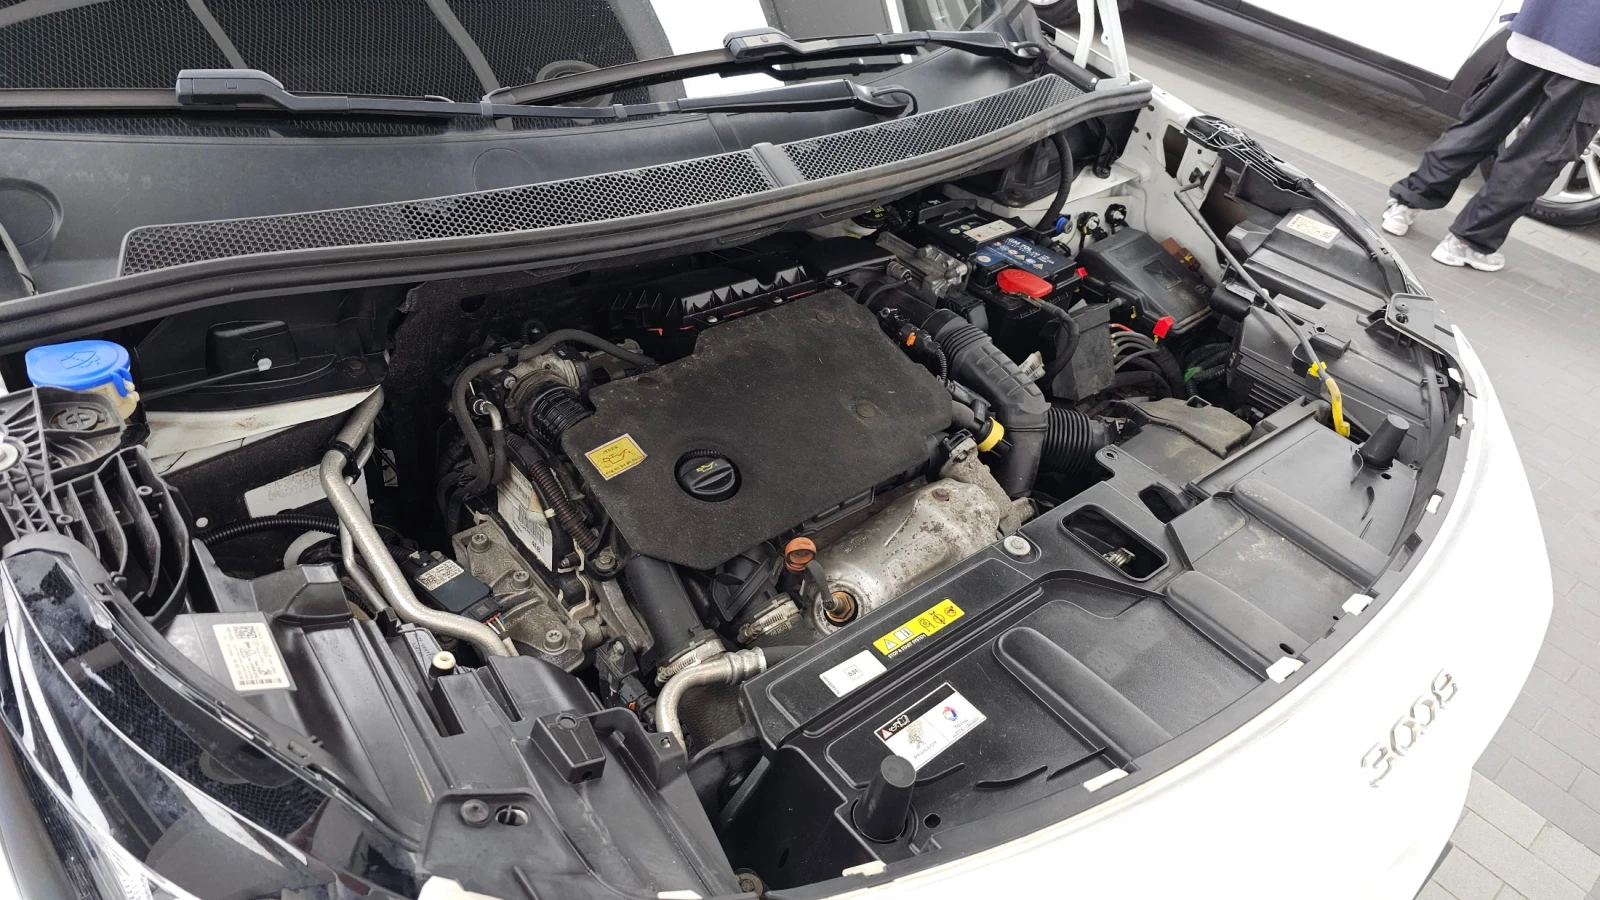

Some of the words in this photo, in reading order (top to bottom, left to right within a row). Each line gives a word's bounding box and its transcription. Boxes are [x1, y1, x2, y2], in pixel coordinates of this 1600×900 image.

[888, 650, 898, 659] STOP
[900, 641, 913, 651] START
[911, 633, 927, 645] SYSTEM
[954, 718, 969, 729] TOTAL
[1360, 667, 1458, 789] 3008
[913, 740, 937, 760] PEUGEOT
